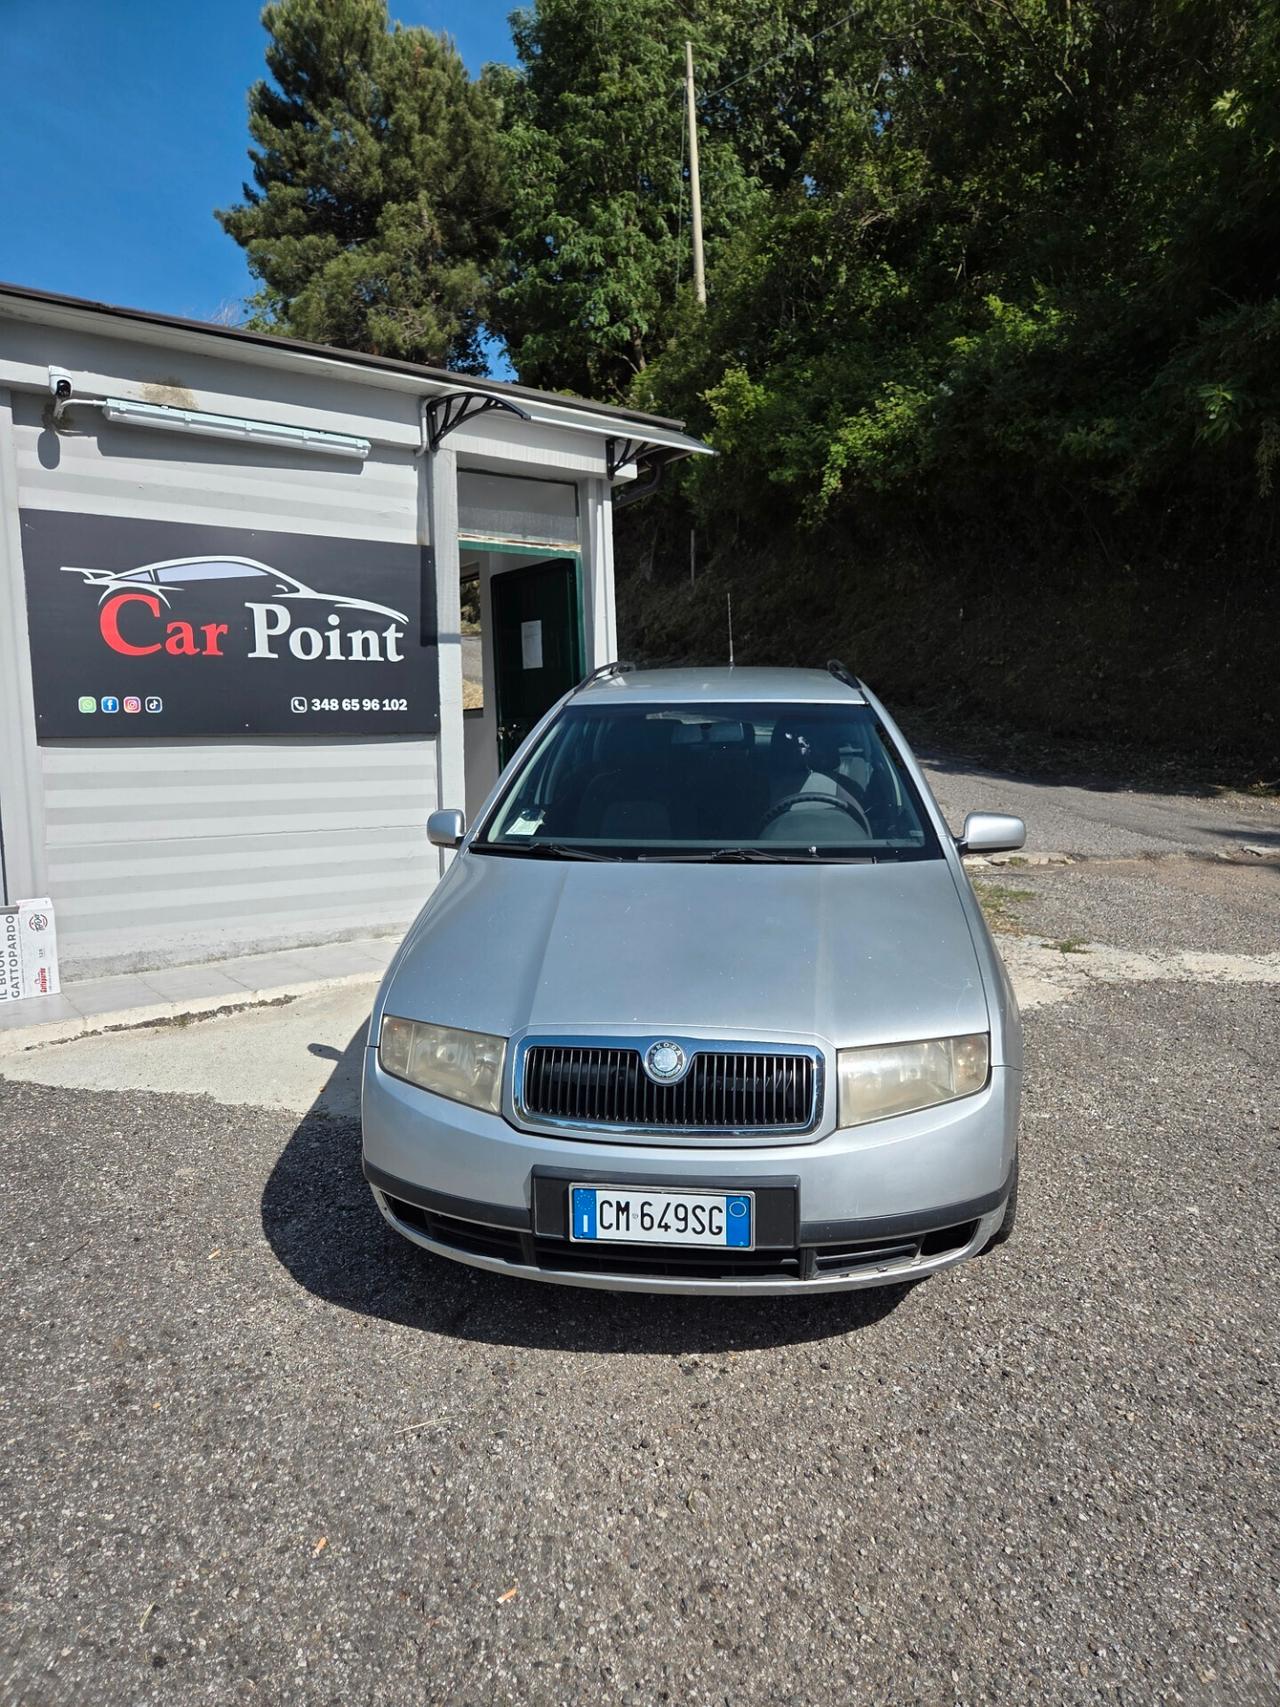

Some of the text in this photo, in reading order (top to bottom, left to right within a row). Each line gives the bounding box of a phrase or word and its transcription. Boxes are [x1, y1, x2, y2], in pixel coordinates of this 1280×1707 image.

[100, 593, 405, 662] Car Point
[311, 698, 408, 711] 348 65 96 102
[5, 915, 20, 999] GATTOPARDO
